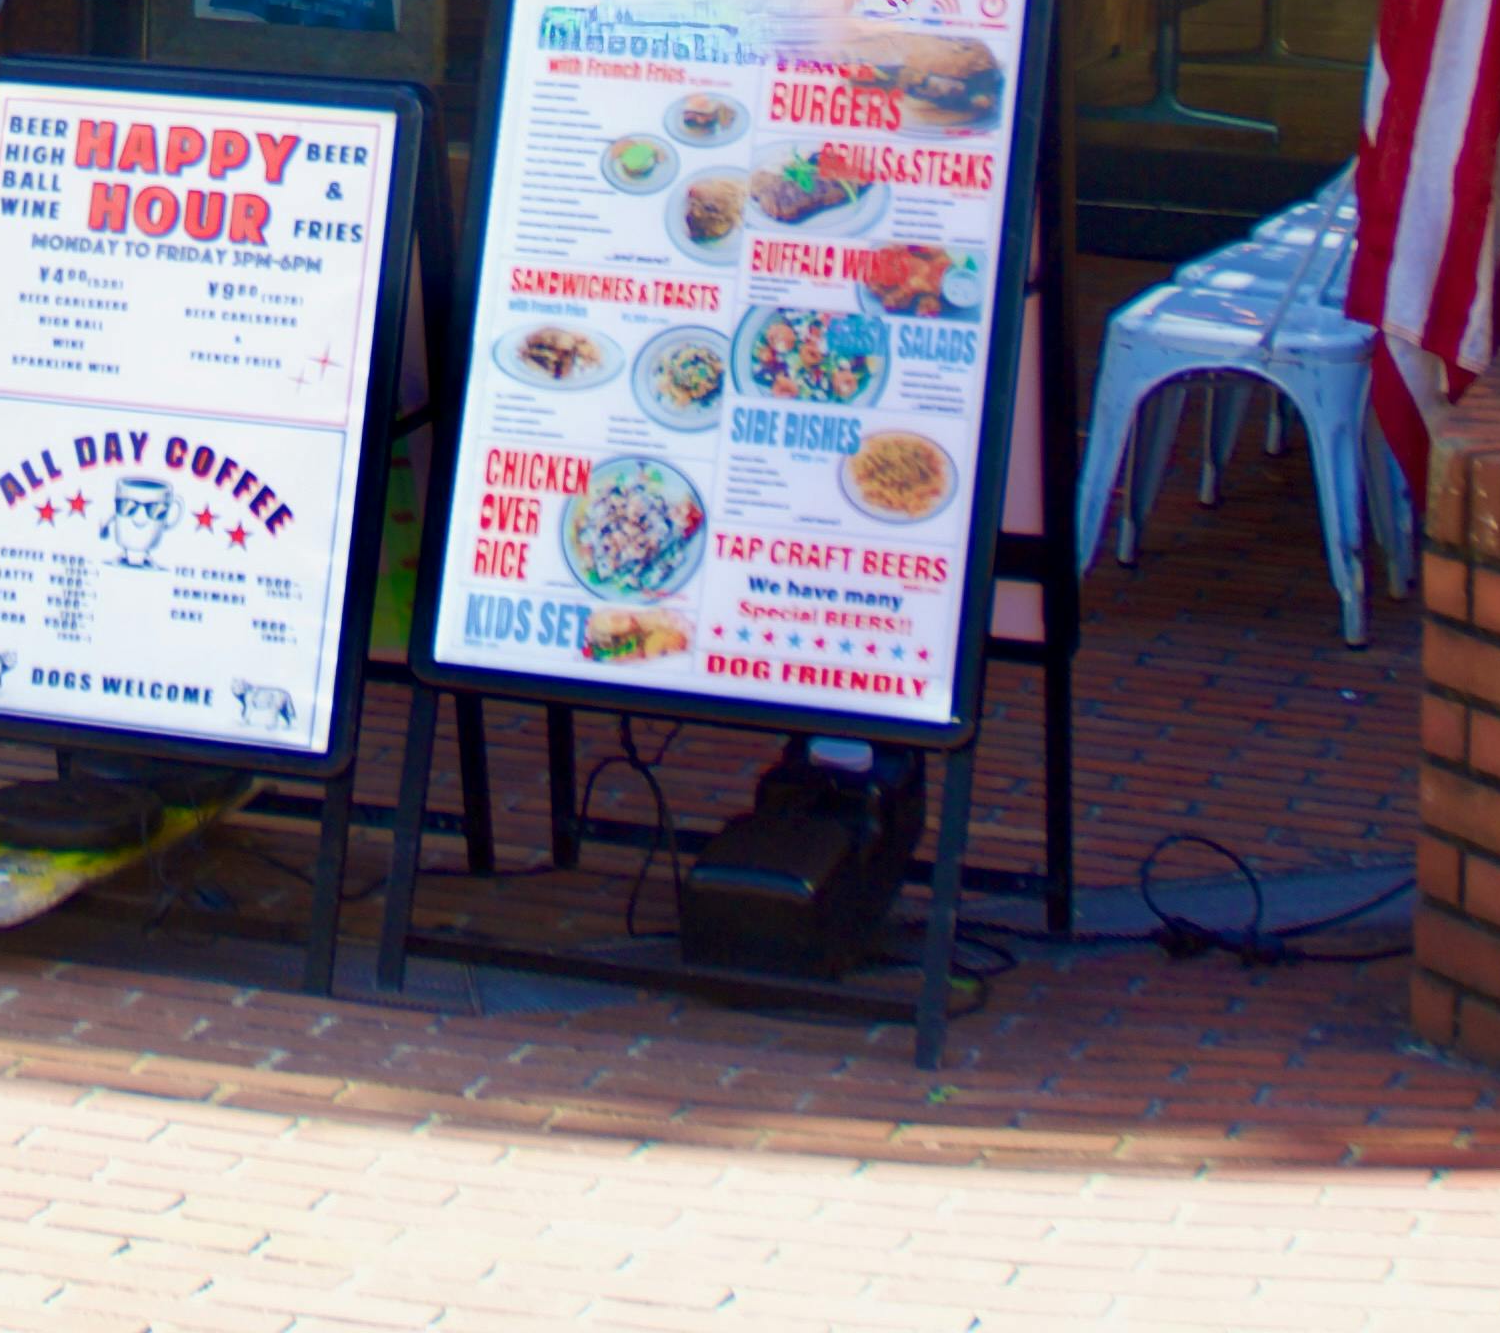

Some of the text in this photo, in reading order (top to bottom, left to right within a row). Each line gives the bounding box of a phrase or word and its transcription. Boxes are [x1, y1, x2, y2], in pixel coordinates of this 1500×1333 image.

[586, 58, 642, 81] French
[646, 62, 687, 84] Fries
[770, 82, 904, 132] BURGERS
[9, 116, 68, 138] BEER
[5, 143, 65, 166] HIGH
[74, 118, 301, 185] HAPPY
[306, 143, 368, 165] BEER
[2, 170, 62, 193] BALL
[325, 181, 343, 200] &
[0, 197, 60, 219] WINE
[87, 181, 270, 246] HOUR
[293, 218, 363, 243] FRIES
[31, 233, 323, 274] MONDAY TO FRIDAY 3PM-6PM
[751, 239, 835, 278] BUFFALO
[19, 292, 49, 305] BEER
[511, 266, 634, 303] SANDWICHES
[638, 283, 648, 304] &
[654, 281, 720, 312] TOASTS
[185, 307, 216, 319] BEER
[53, 338, 84, 350] WINE
[190, 350, 281, 368] FRENCH FRIES
[897, 323, 977, 365] SALADS
[12, 354, 120, 374] SPARKLING WINE
[730, 406, 862, 456] SIDE DISHES
[74, 431, 149, 469] DAY
[165, 436, 295, 537] COFFEE
[485, 448, 592, 496] CHICKEN
[480, 493, 541, 535] OVER
[473, 538, 530, 580] RICE
[714, 533, 949, 583] TAP CRAFT BEERS
[738, 600, 818, 623] Special
[748, 575, 903, 612] We have many
[464, 593, 592, 650] KIDS SET
[32, 666, 213, 707] DOGS WELCOME
[706, 654, 928, 698] DOG FRIENDLY
